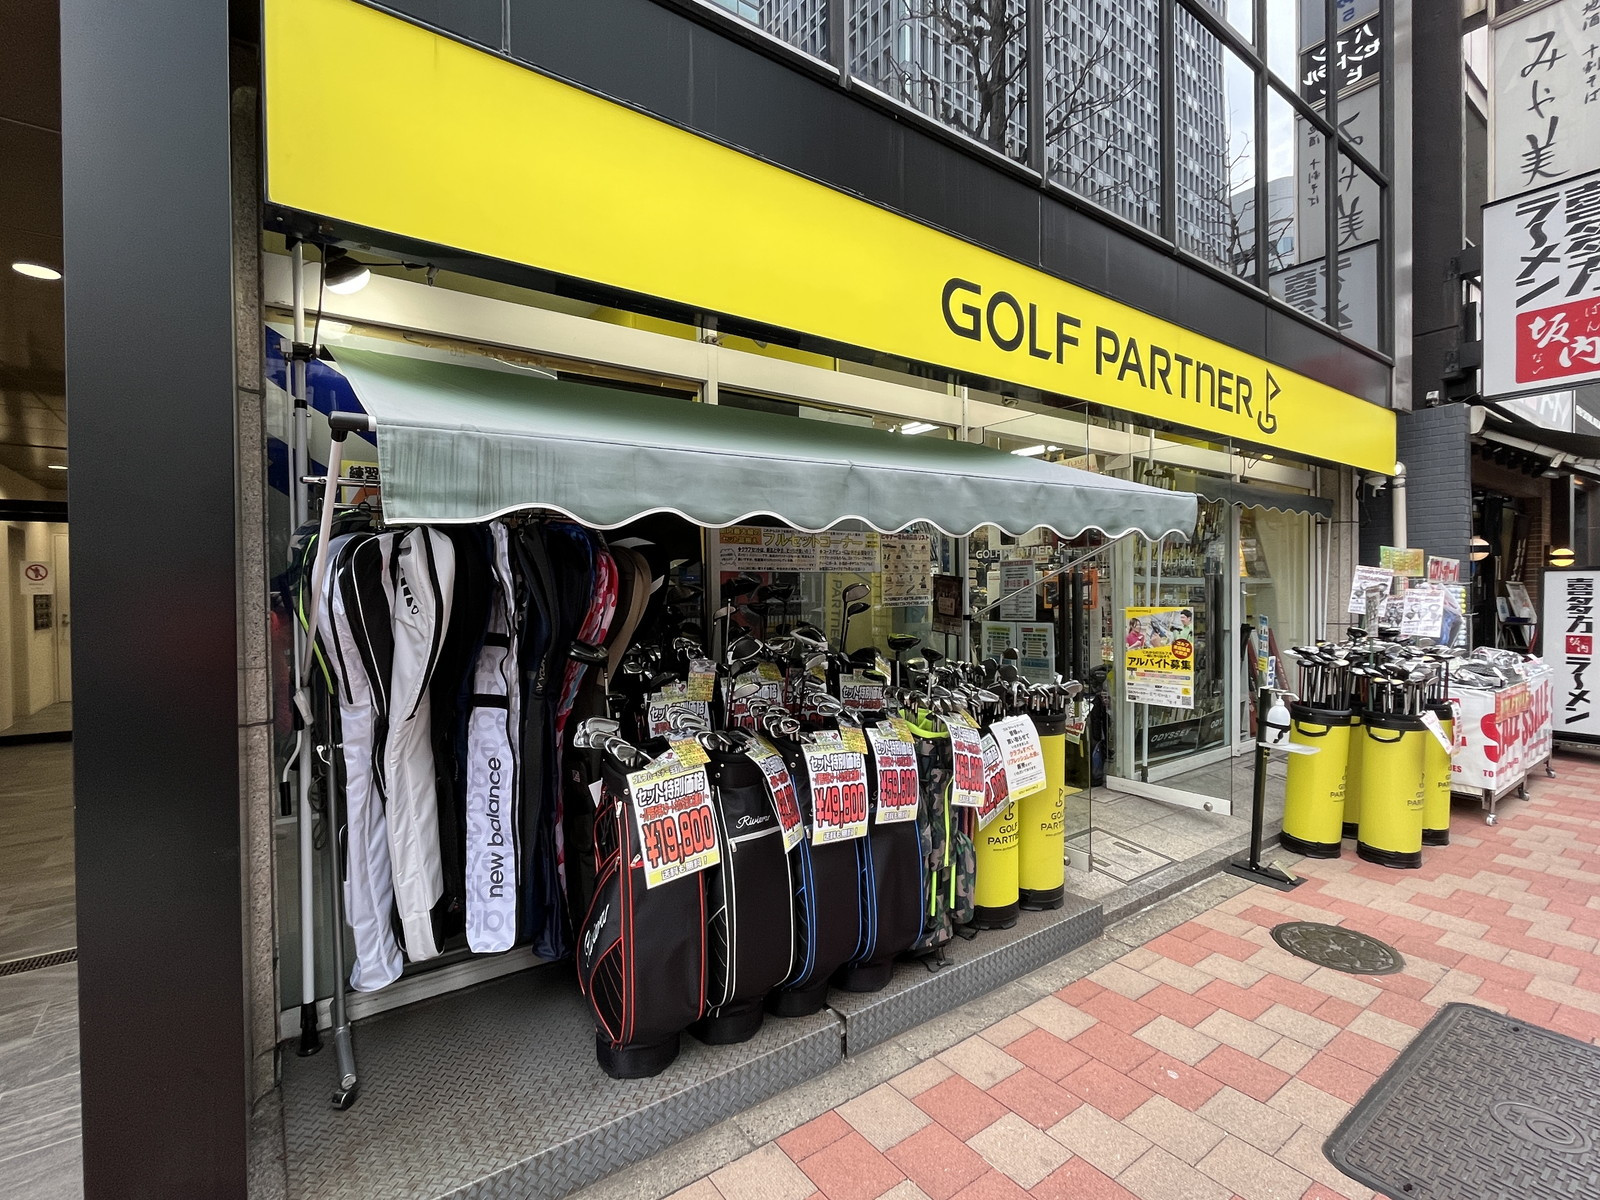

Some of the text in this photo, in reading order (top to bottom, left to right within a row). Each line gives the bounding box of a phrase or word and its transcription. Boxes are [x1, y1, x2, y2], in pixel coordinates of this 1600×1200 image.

[941, 277, 1254, 419] GOLF PARTNER
[763, 532, 863, 549] フルセットコーナー
[1566, 578, 1594, 634] 喜多方
[1128, 656, 1191, 671] アルバイト募集
[636, 771, 706, 807] セット特別価格
[814, 782, 866, 828] ¥49,800
[487, 757, 504, 898] new balance
[642, 805, 716, 868] ¥19,800
